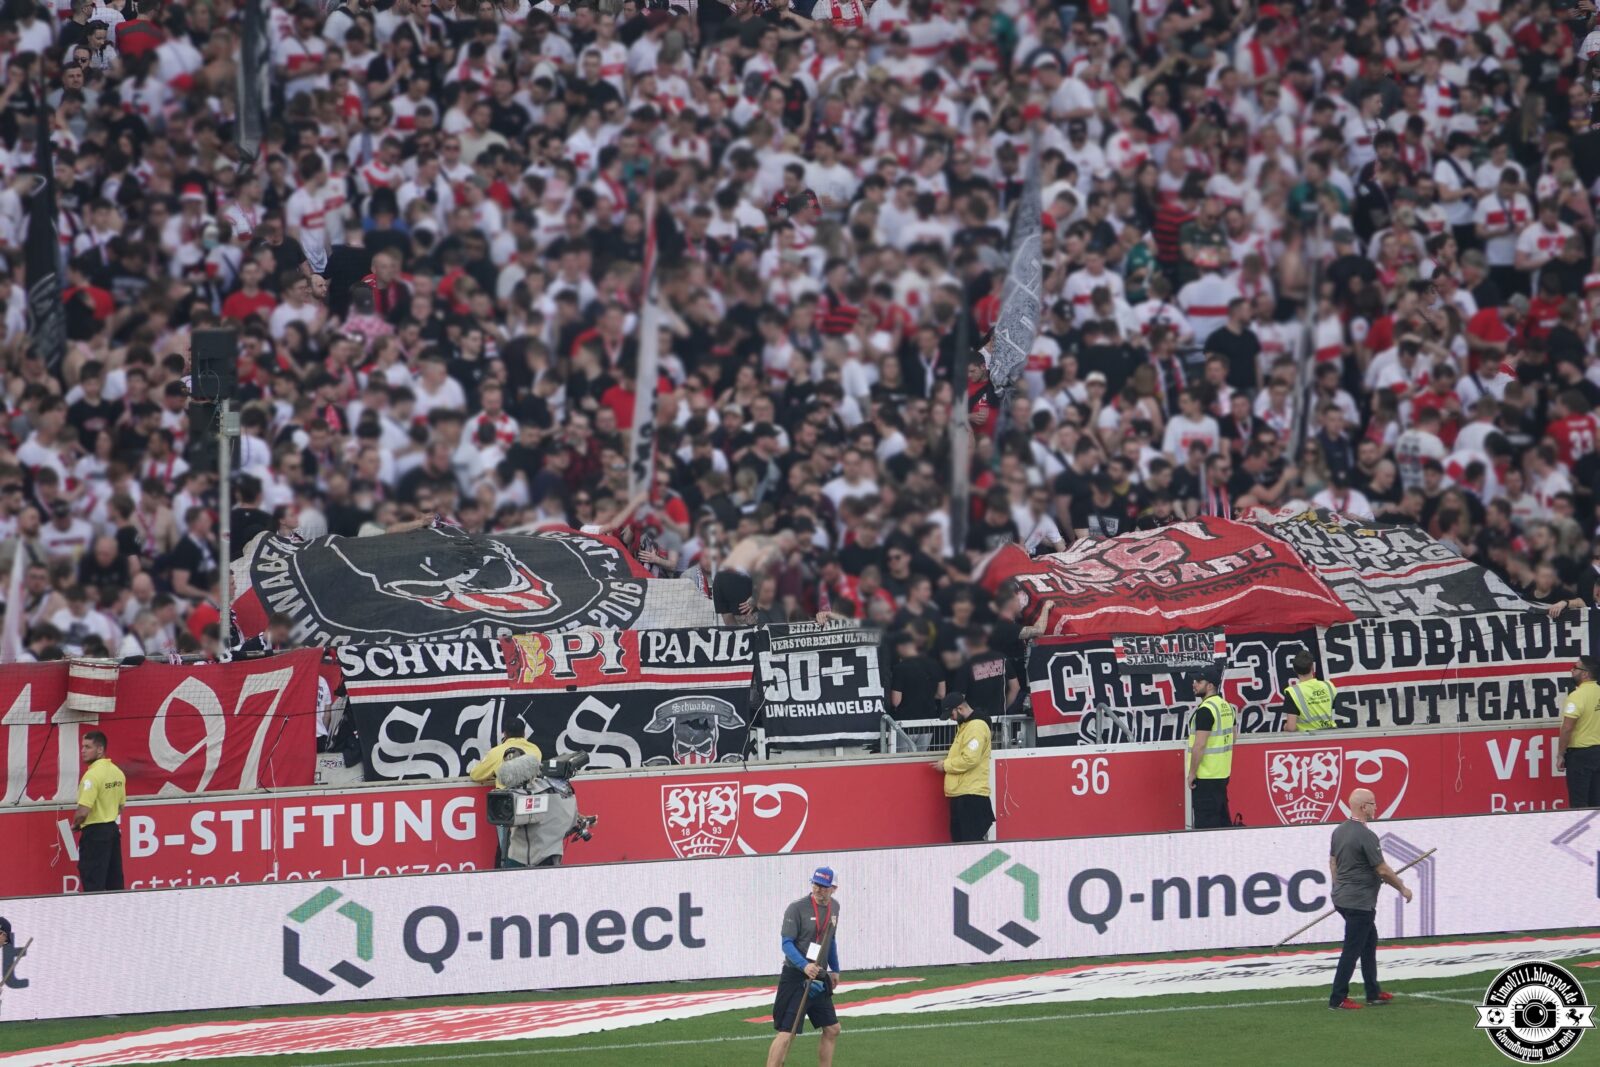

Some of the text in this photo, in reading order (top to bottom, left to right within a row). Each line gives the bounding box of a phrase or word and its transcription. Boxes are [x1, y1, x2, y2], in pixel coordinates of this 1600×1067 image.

[771, 634, 844, 651] VERSTORBENEN
[1122, 632, 1215, 654] SEKTION
[1325, 614, 1583, 675] SÜDBANDE
[758, 645, 885, 701] 50+1
[672, 701, 716, 714] Schwaben
[765, 699, 887, 718] UNVERHANDELBA
[148, 665, 294, 795] 97
[1071, 757, 1110, 797] 36
[1284, 791, 1325, 801] 18 93
[57, 796, 477, 862] VB-STIFTUNG
[681, 826, 723, 836] 18 93
[1068, 867, 1327, 935] Q-nnec
[403, 891, 706, 974] Q-nnect
